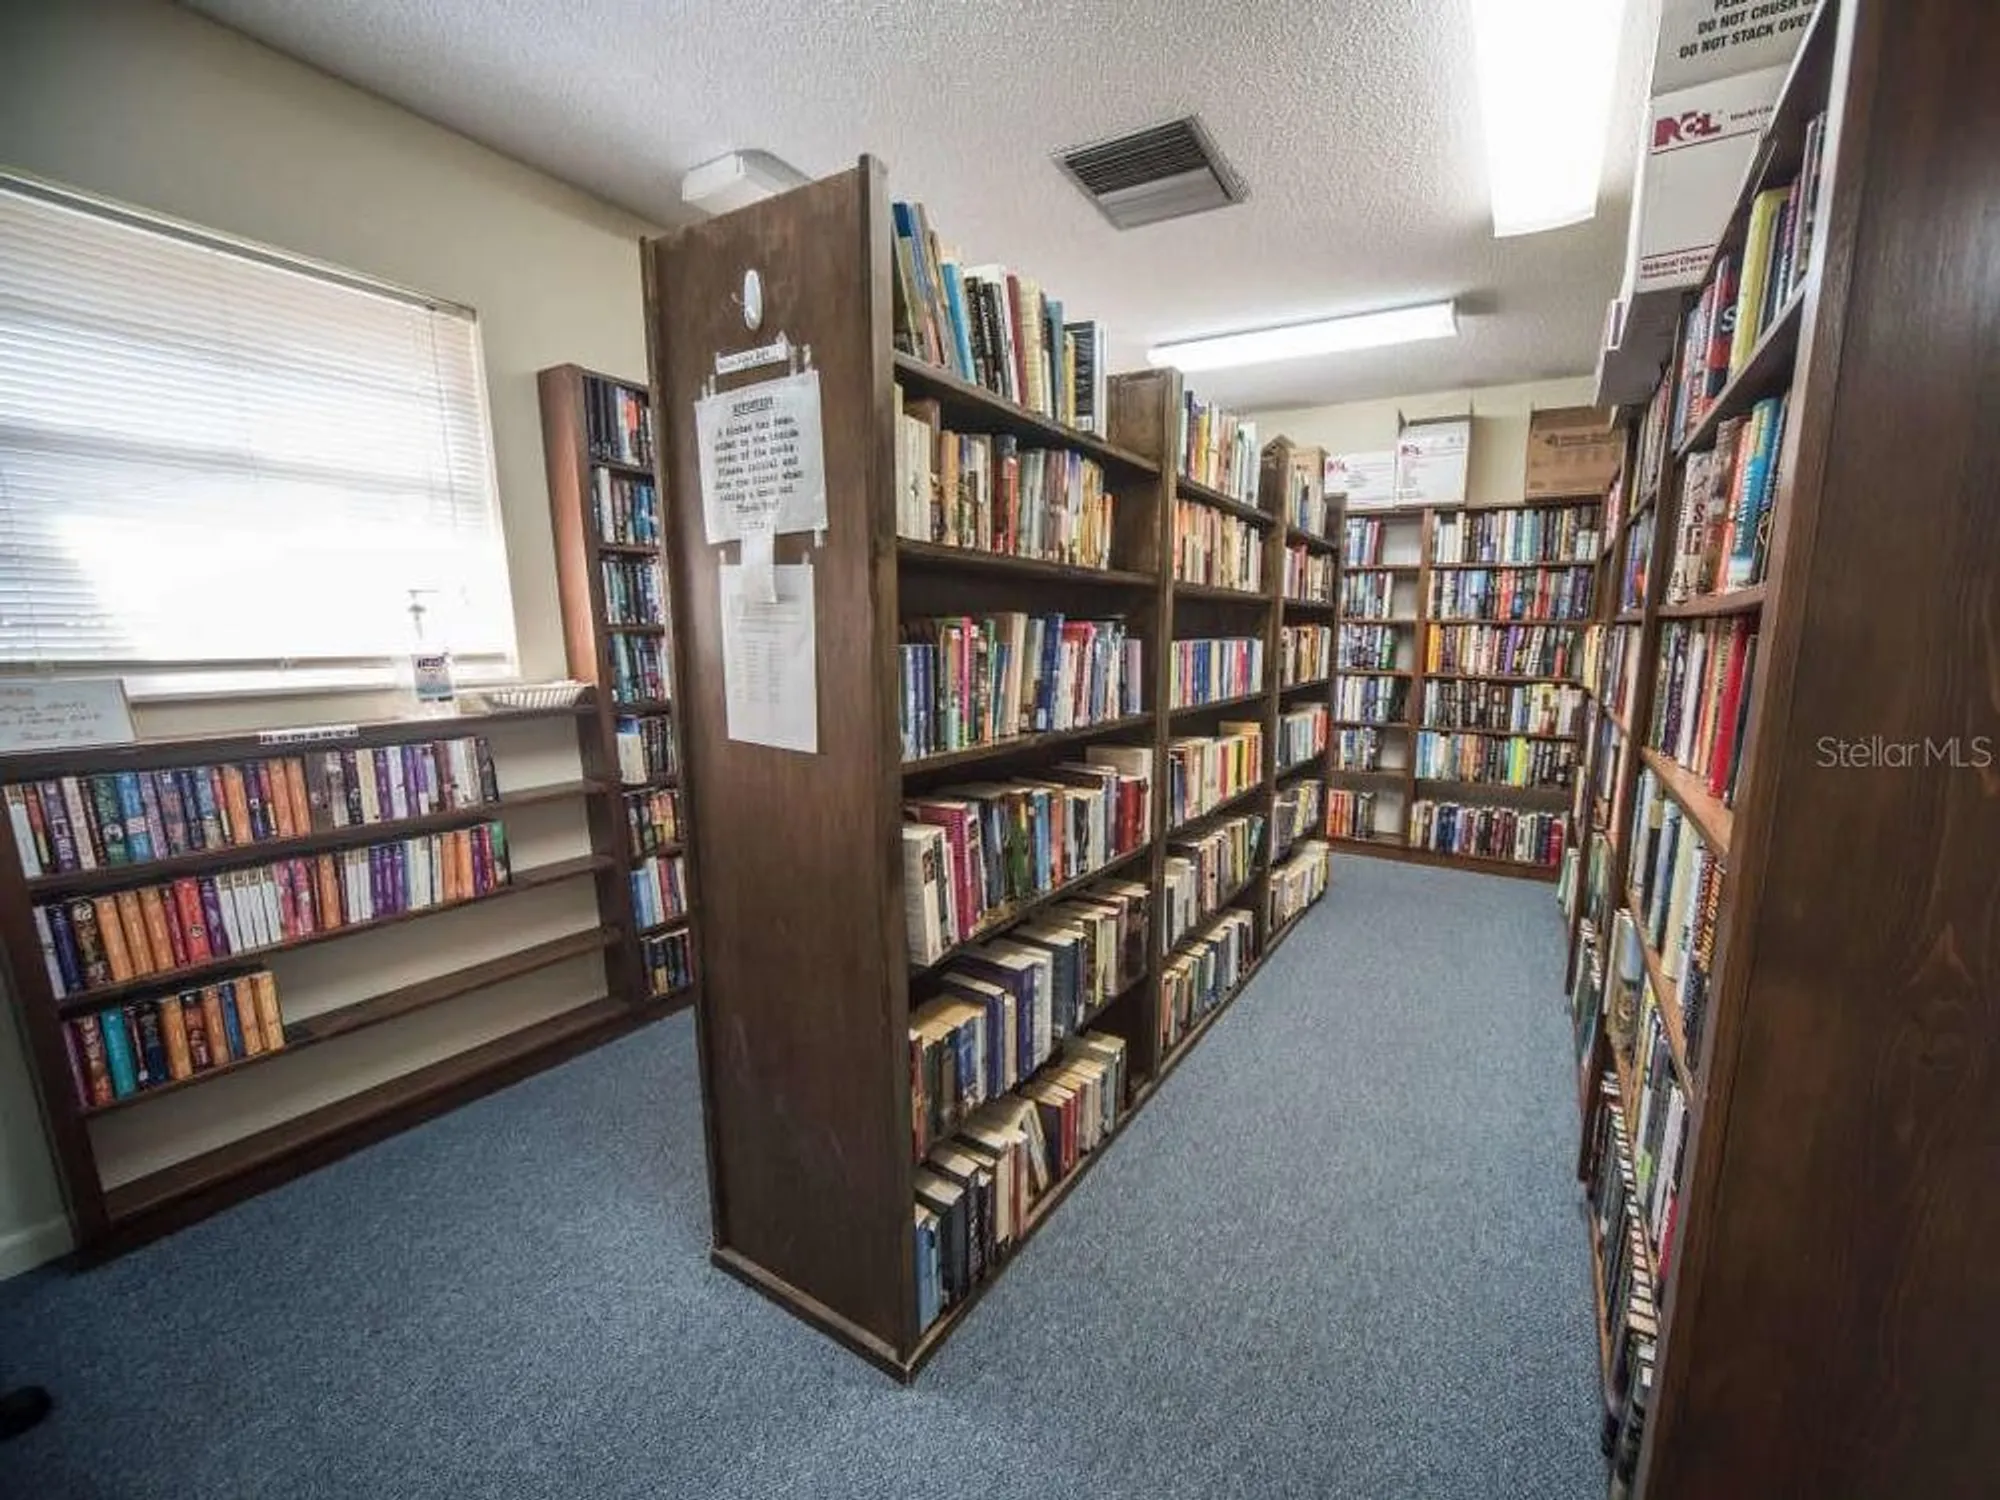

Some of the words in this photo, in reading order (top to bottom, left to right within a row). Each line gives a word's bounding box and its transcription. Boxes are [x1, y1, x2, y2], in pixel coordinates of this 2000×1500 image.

[1698, 19, 1717, 35] DO
[1720, 10, 1747, 28] NOT
[1751, 0, 1798, 20] CRUSH
[1679, 43, 1698, 59] DO
[1701, 36, 1728, 53] NOT
[1731, 22, 1774, 45] STACK
